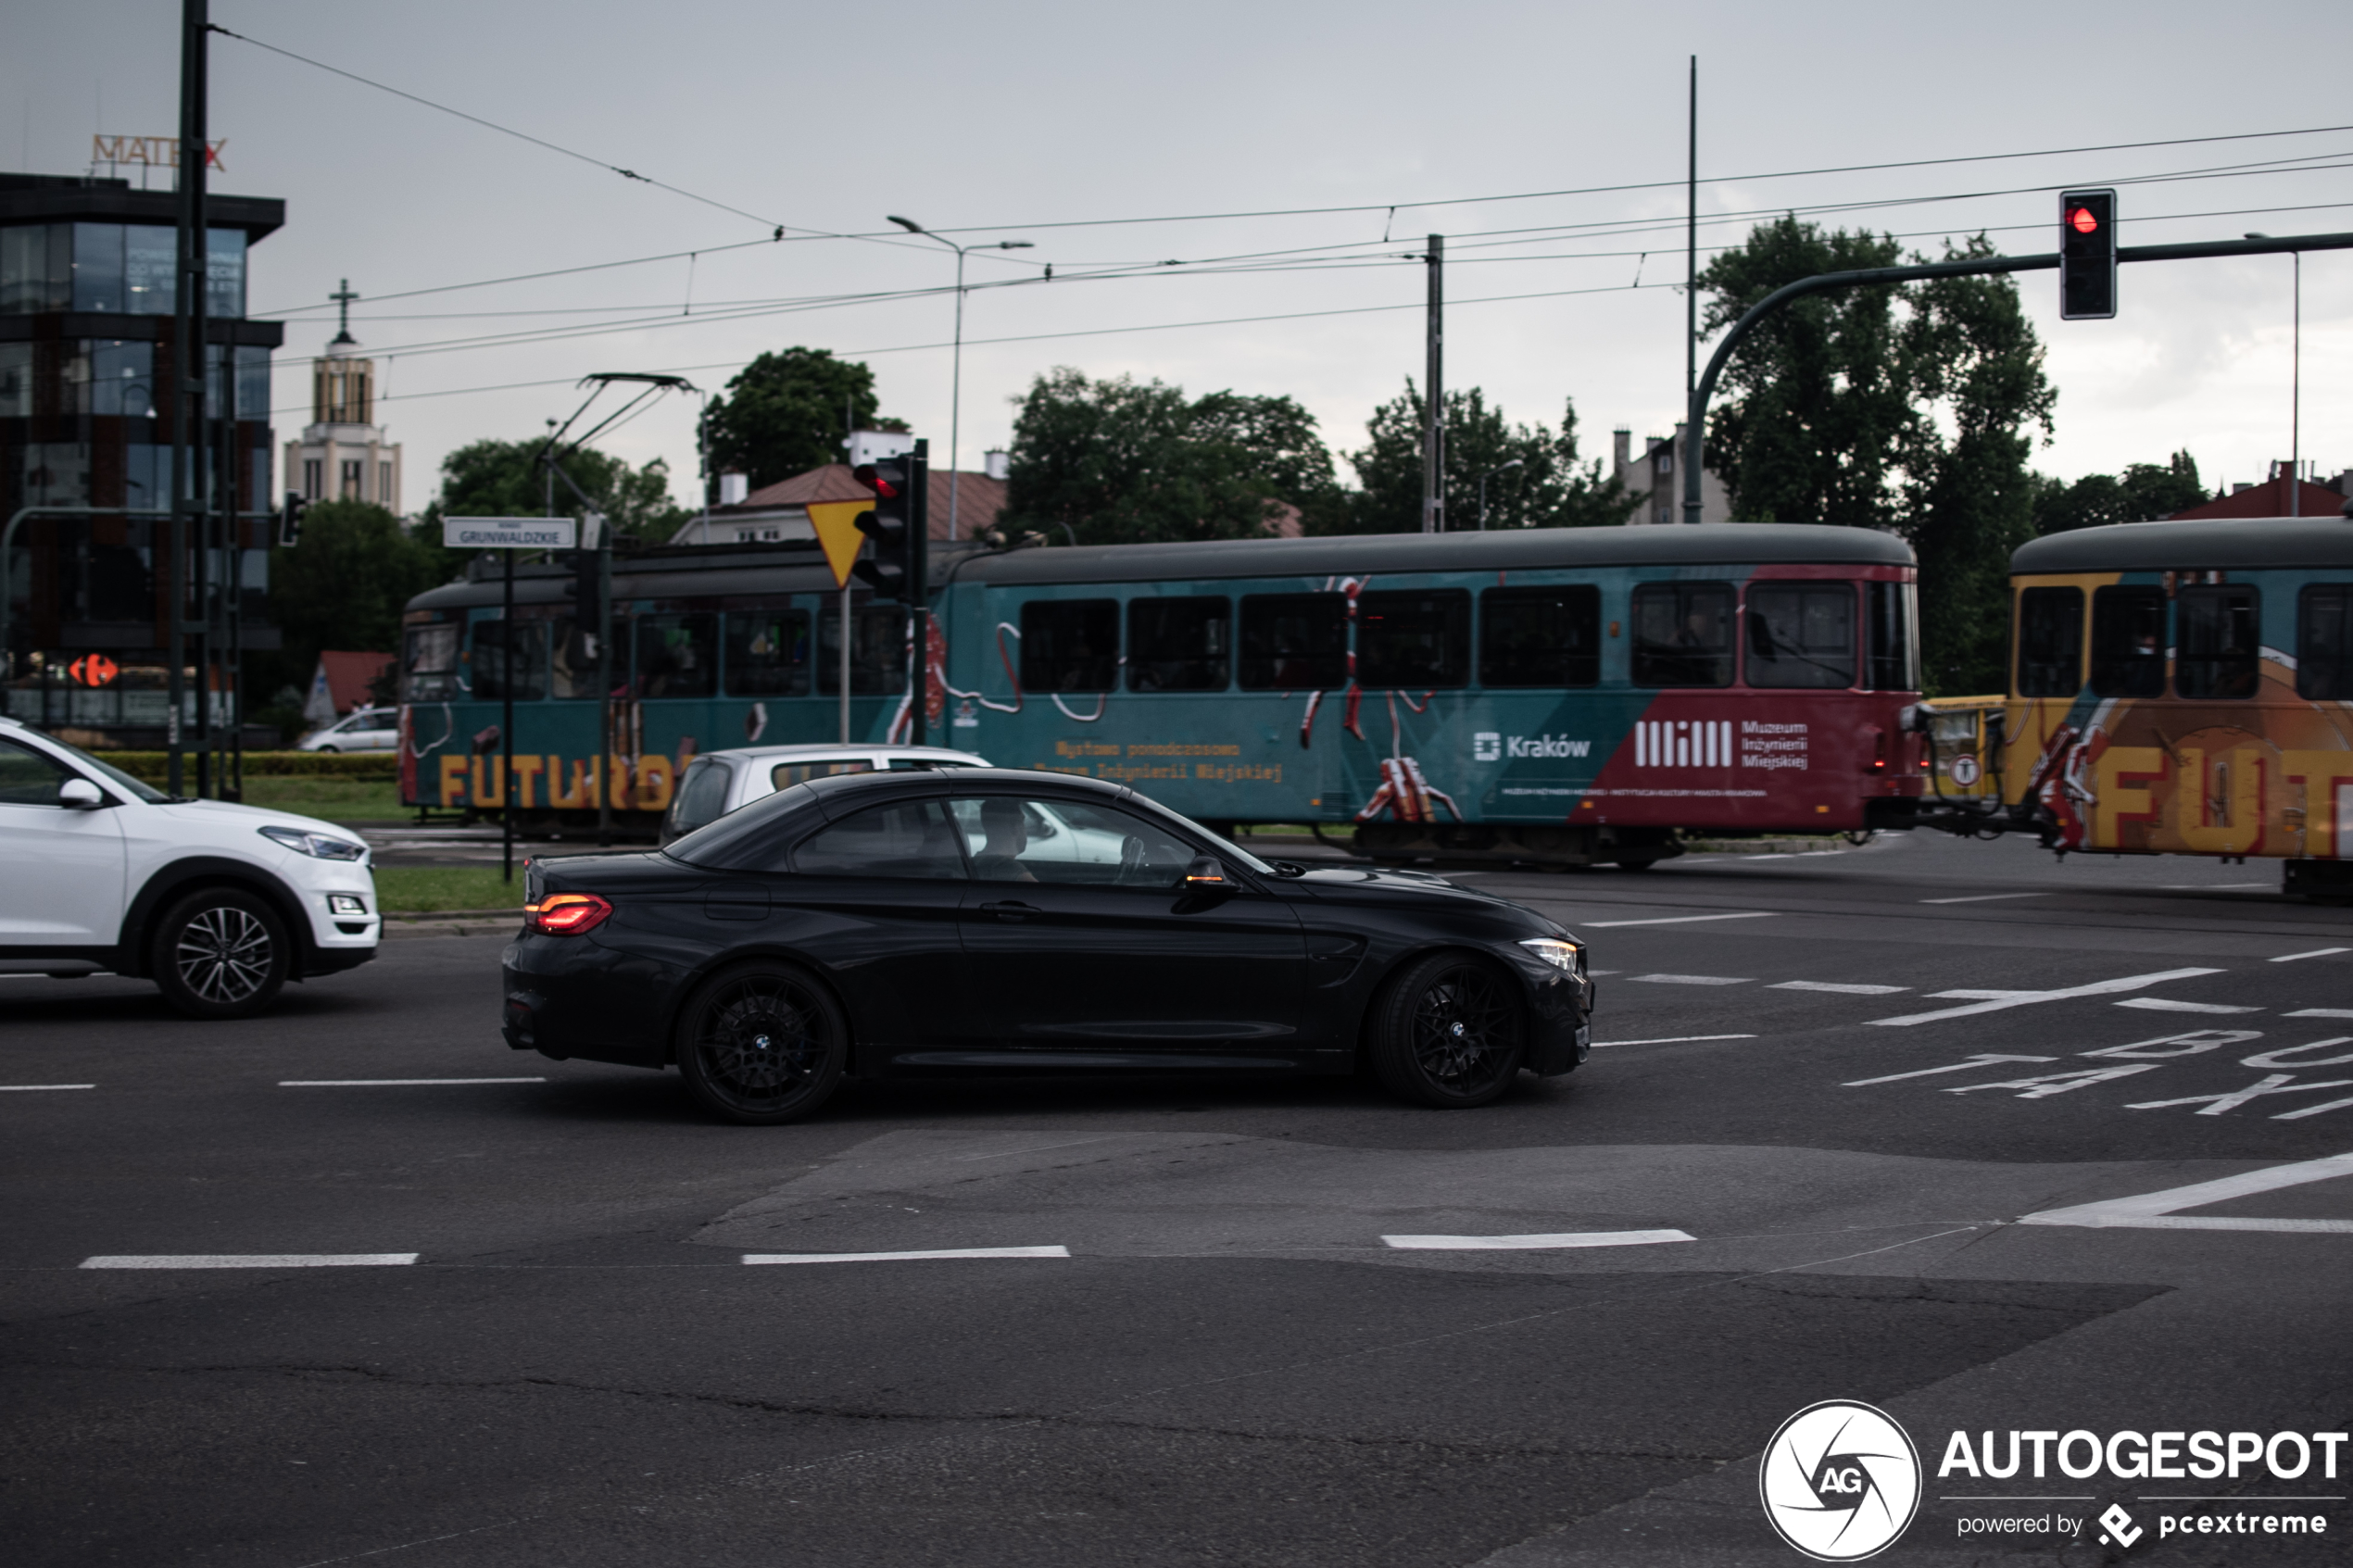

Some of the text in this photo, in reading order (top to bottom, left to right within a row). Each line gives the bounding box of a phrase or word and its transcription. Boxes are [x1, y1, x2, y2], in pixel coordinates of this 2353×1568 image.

[459, 531, 561, 545] GRUNWALDZKIE
[1742, 721, 1807, 734] Muzeum
[1506, 734, 1591, 758] Kraków
[1742, 754, 1807, 771] Miejskiej
[439, 754, 696, 811] FUTURO
